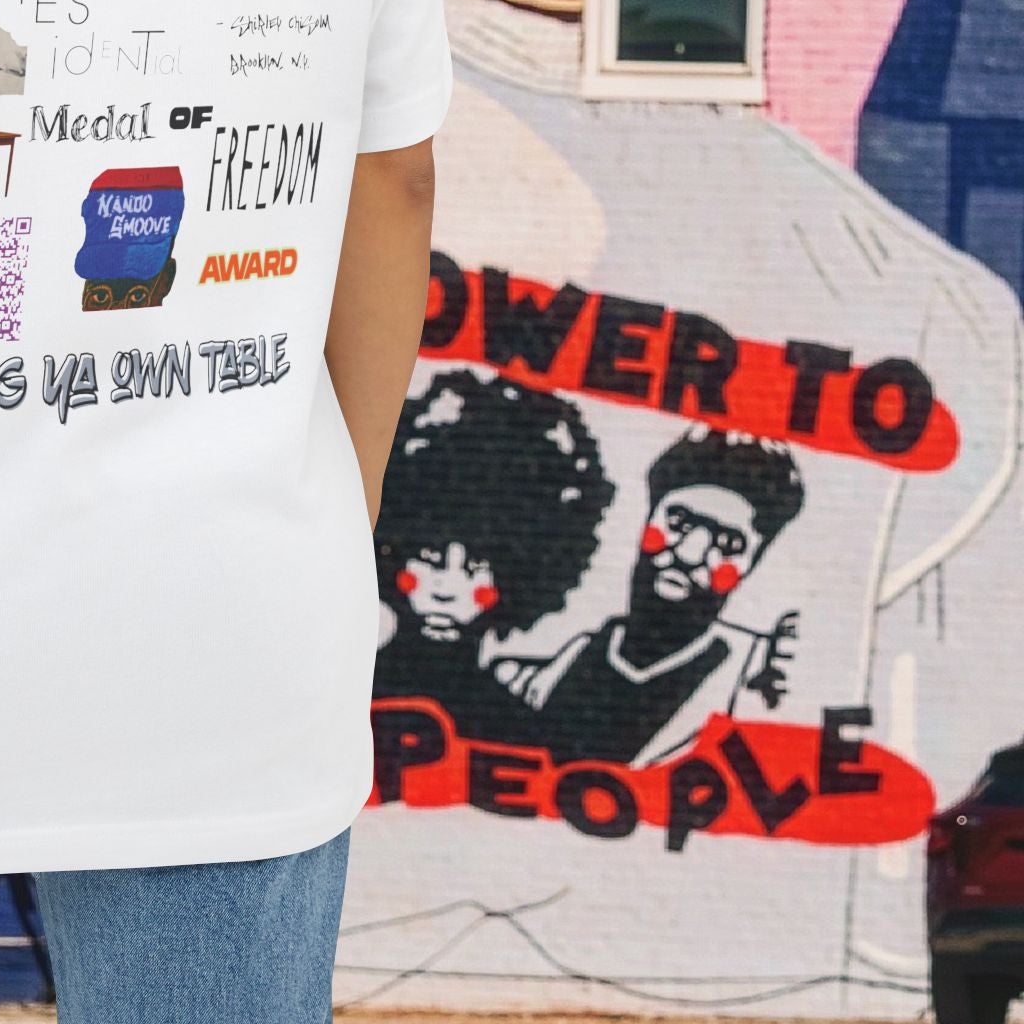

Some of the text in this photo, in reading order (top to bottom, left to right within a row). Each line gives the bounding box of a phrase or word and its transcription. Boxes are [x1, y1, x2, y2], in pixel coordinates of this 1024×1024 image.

[28, 102, 214, 143] Medal OF
[206, 121, 324, 212] FREEDOM
[198, 247, 298, 285] AWARD
[42, 351, 99, 426] YA
[110, 339, 192, 404] OWN
[198, 332, 291, 393] TABLE
[785, 339, 934, 455] TO
[373, 707, 882, 853] PEOPLE
